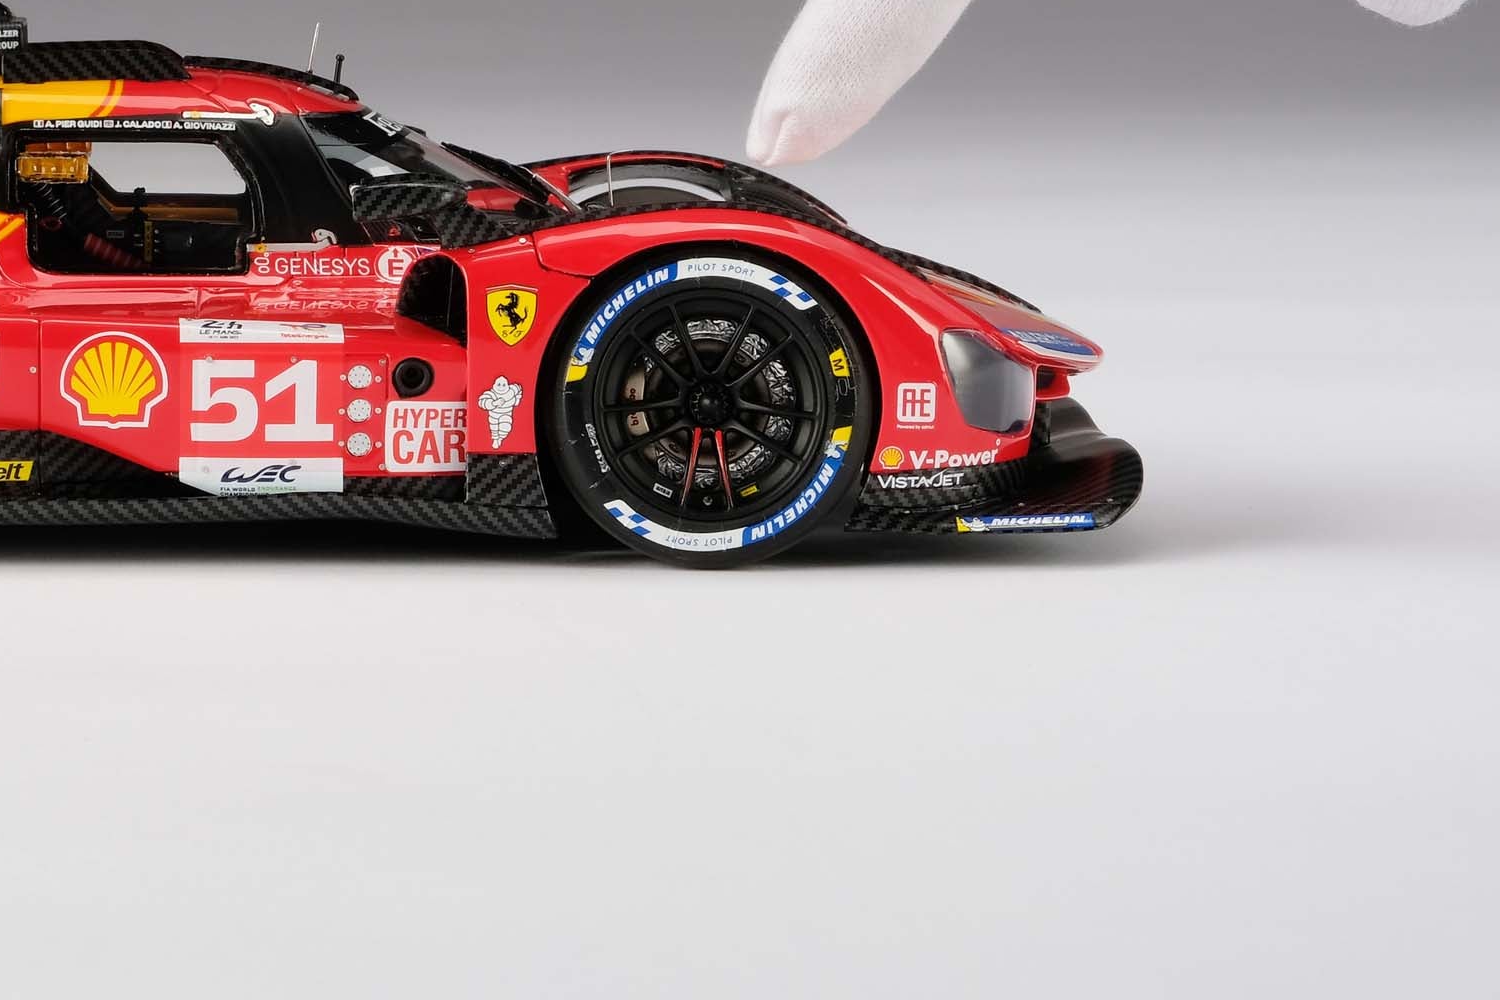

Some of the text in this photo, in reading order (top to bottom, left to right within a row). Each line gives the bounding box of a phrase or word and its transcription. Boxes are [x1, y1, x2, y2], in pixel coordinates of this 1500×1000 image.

[55, 120, 77, 128] PIER
[78, 120, 102, 128] GUIDI
[123, 120, 162, 129] CALADO
[184, 121, 236, 131] GIOVINAZZI
[274, 257, 370, 276] GENESYS
[687, 263, 756, 278] PILOT SPORT
[585, 267, 670, 347] MICHELIN
[189, 359, 335, 442] 51
[393, 407, 467, 429] HYPER
[393, 430, 467, 465] CAR
[909, 448, 998, 470] V-Power
[220, 464, 302, 483] WEC
[751, 463, 835, 541] MICHELIN
[990, 515, 1087, 526] MICHELIN
[704, 536, 733, 546] PILOT
